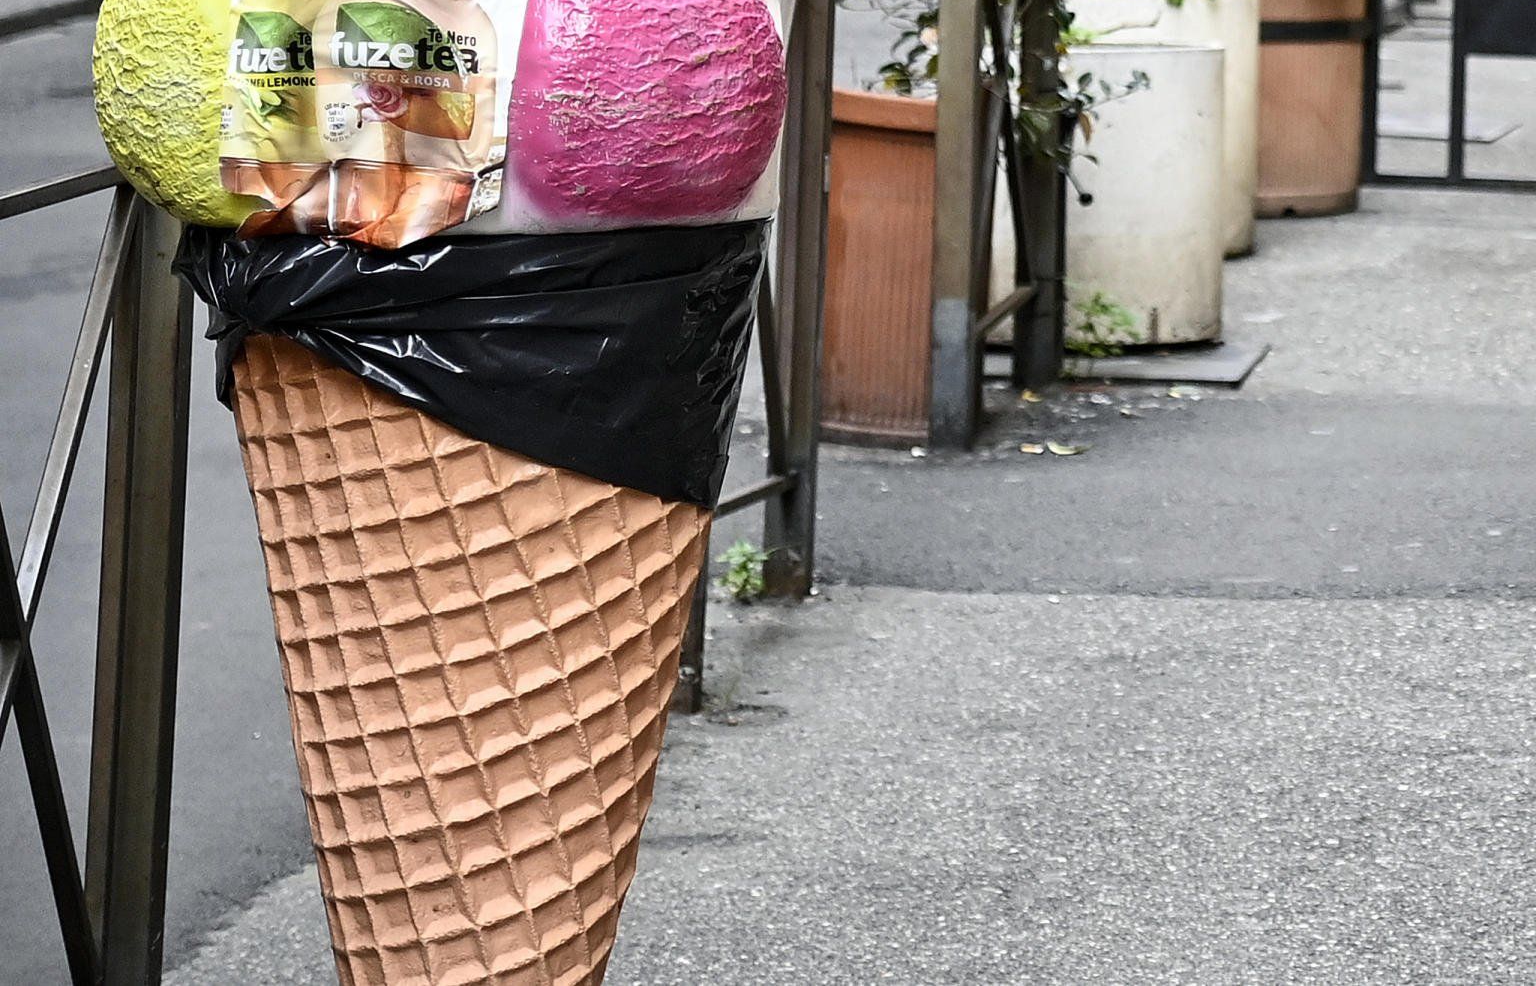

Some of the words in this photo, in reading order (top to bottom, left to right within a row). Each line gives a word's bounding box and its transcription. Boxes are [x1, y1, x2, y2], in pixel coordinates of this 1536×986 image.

[446, 30, 476, 47] Nero
[400, 74, 410, 84] &
[414, 75, 450, 88] ROSA
